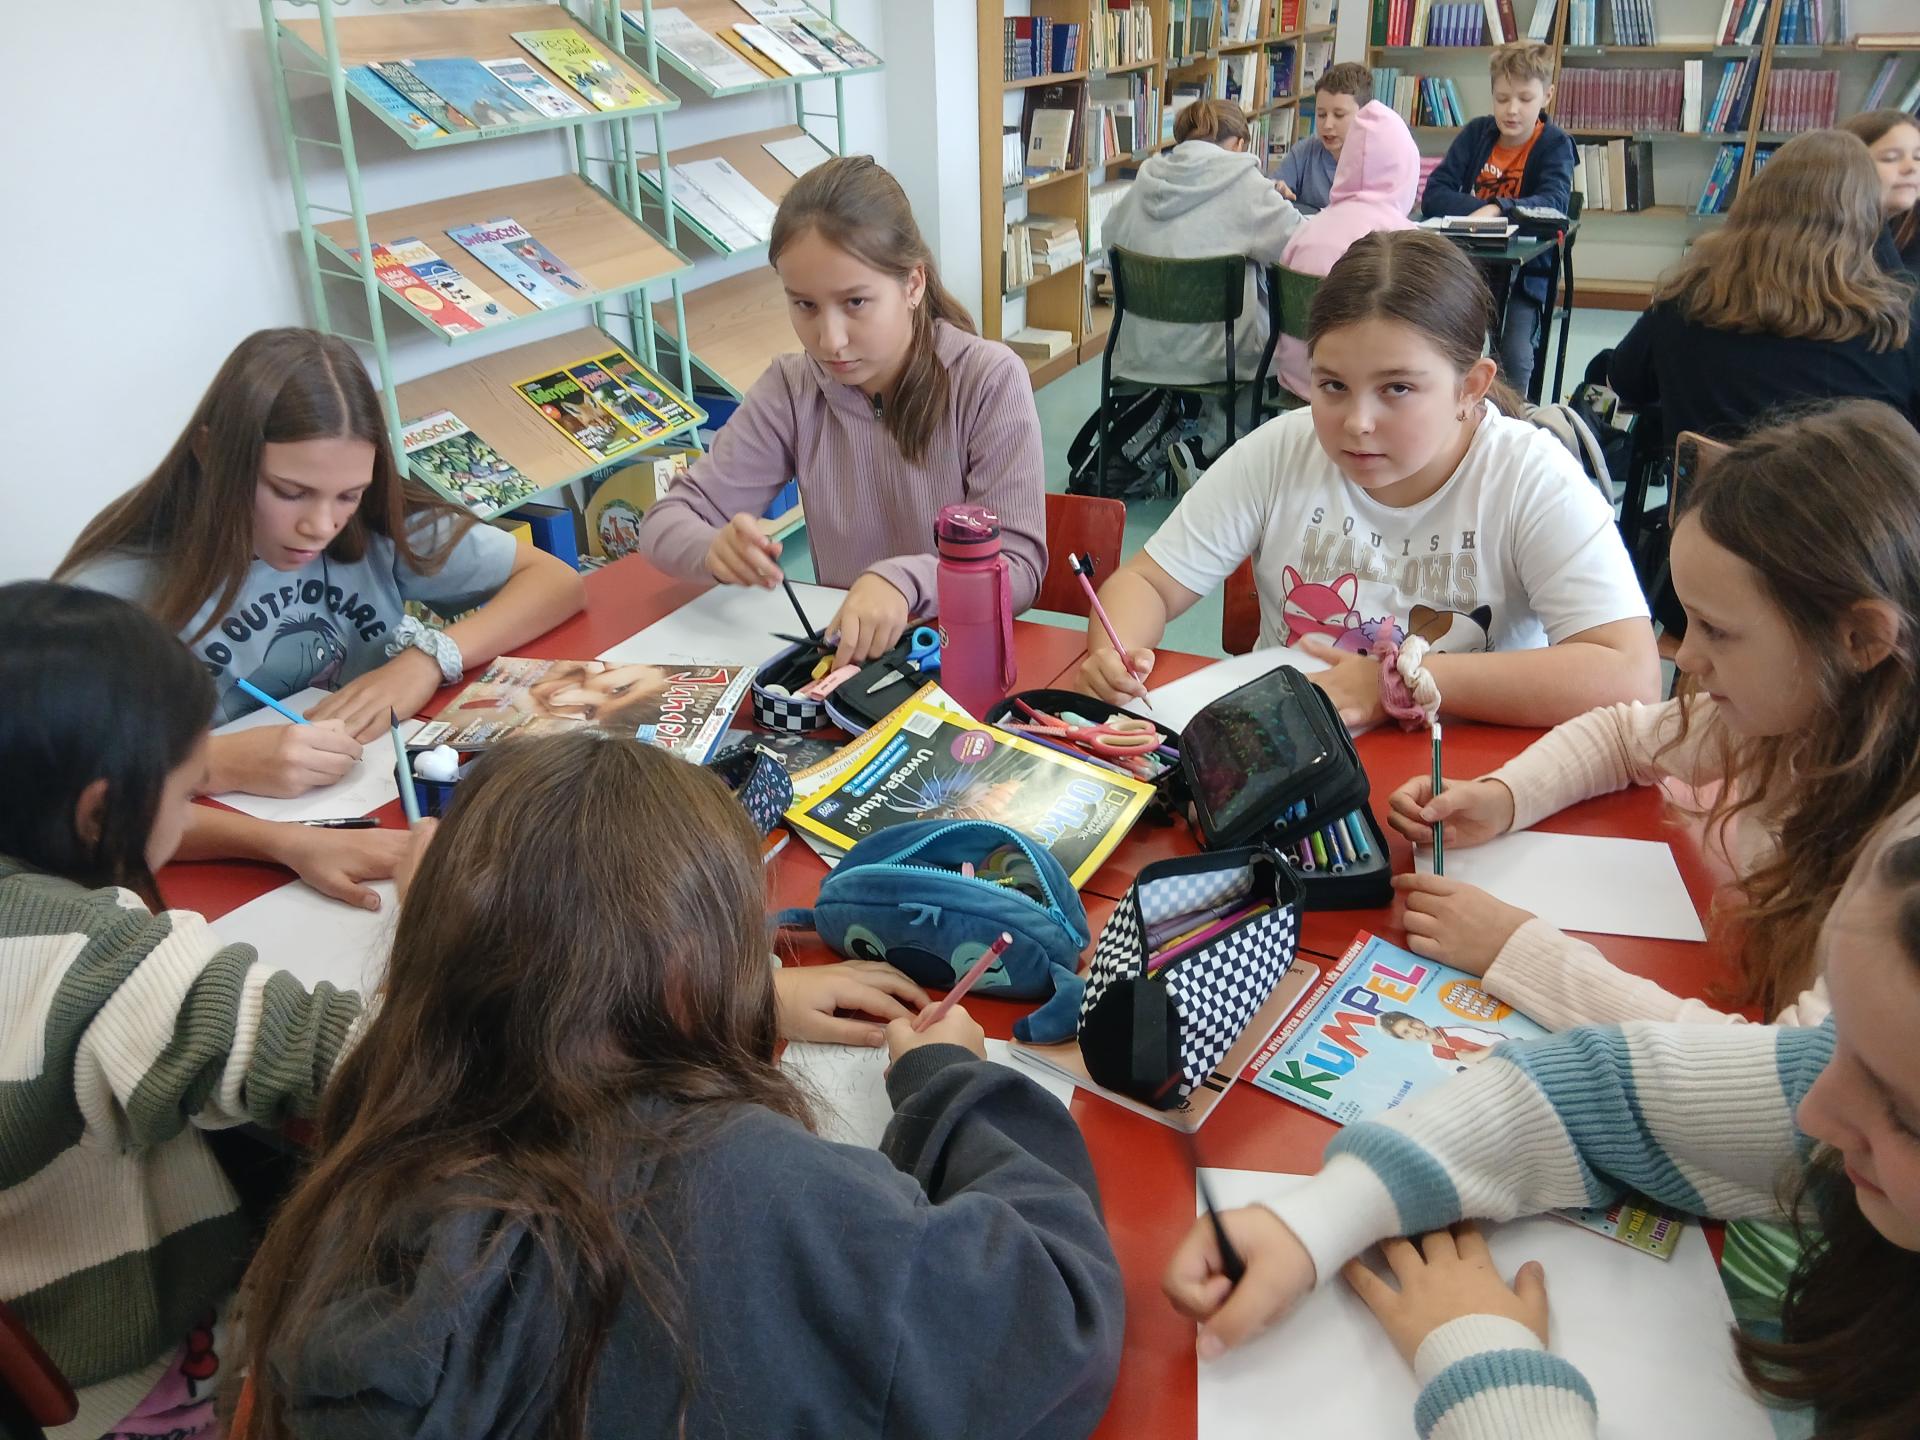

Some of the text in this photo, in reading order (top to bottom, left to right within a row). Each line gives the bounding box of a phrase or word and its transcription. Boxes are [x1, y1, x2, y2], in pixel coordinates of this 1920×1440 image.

[663, 668, 730, 749] Junior
[880, 746, 933, 795] Uwaga,
[1269, 961, 1429, 1102] KUMPEL
